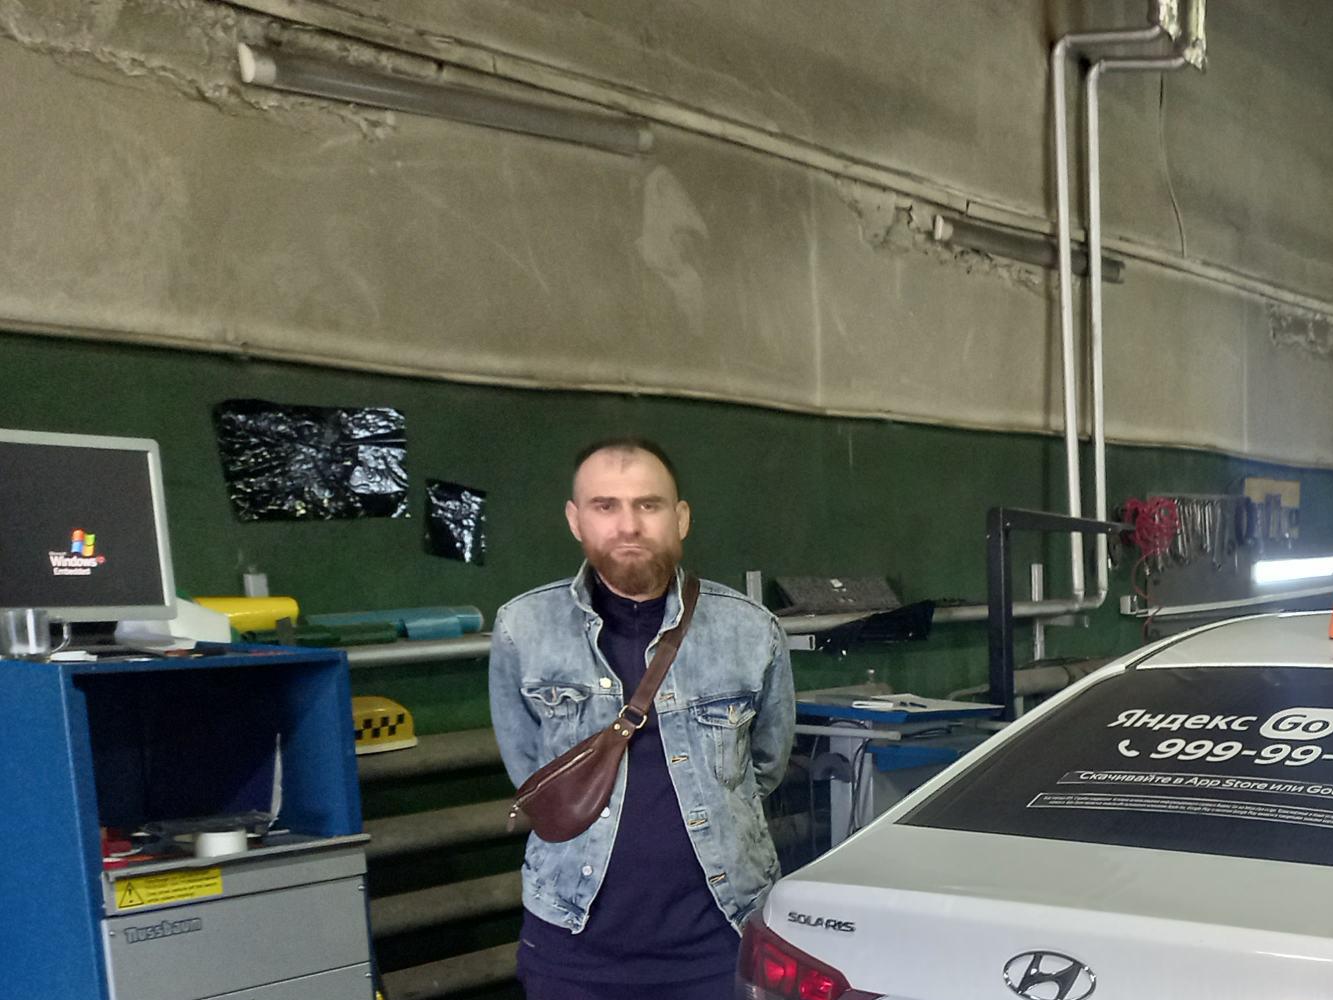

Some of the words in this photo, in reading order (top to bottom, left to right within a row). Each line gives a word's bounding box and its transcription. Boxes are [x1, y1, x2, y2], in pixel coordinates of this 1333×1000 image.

[1107, 709, 1258, 732] Яндекс
[1079, 771, 1169, 785] Скачивайте
[1172, 777, 1182, 785] в
[1184, 777, 1220, 788] App
[1221, 778, 1268, 790] Store
[1269, 782, 1304, 793] или
[787, 911, 856, 932] SOLARIS
